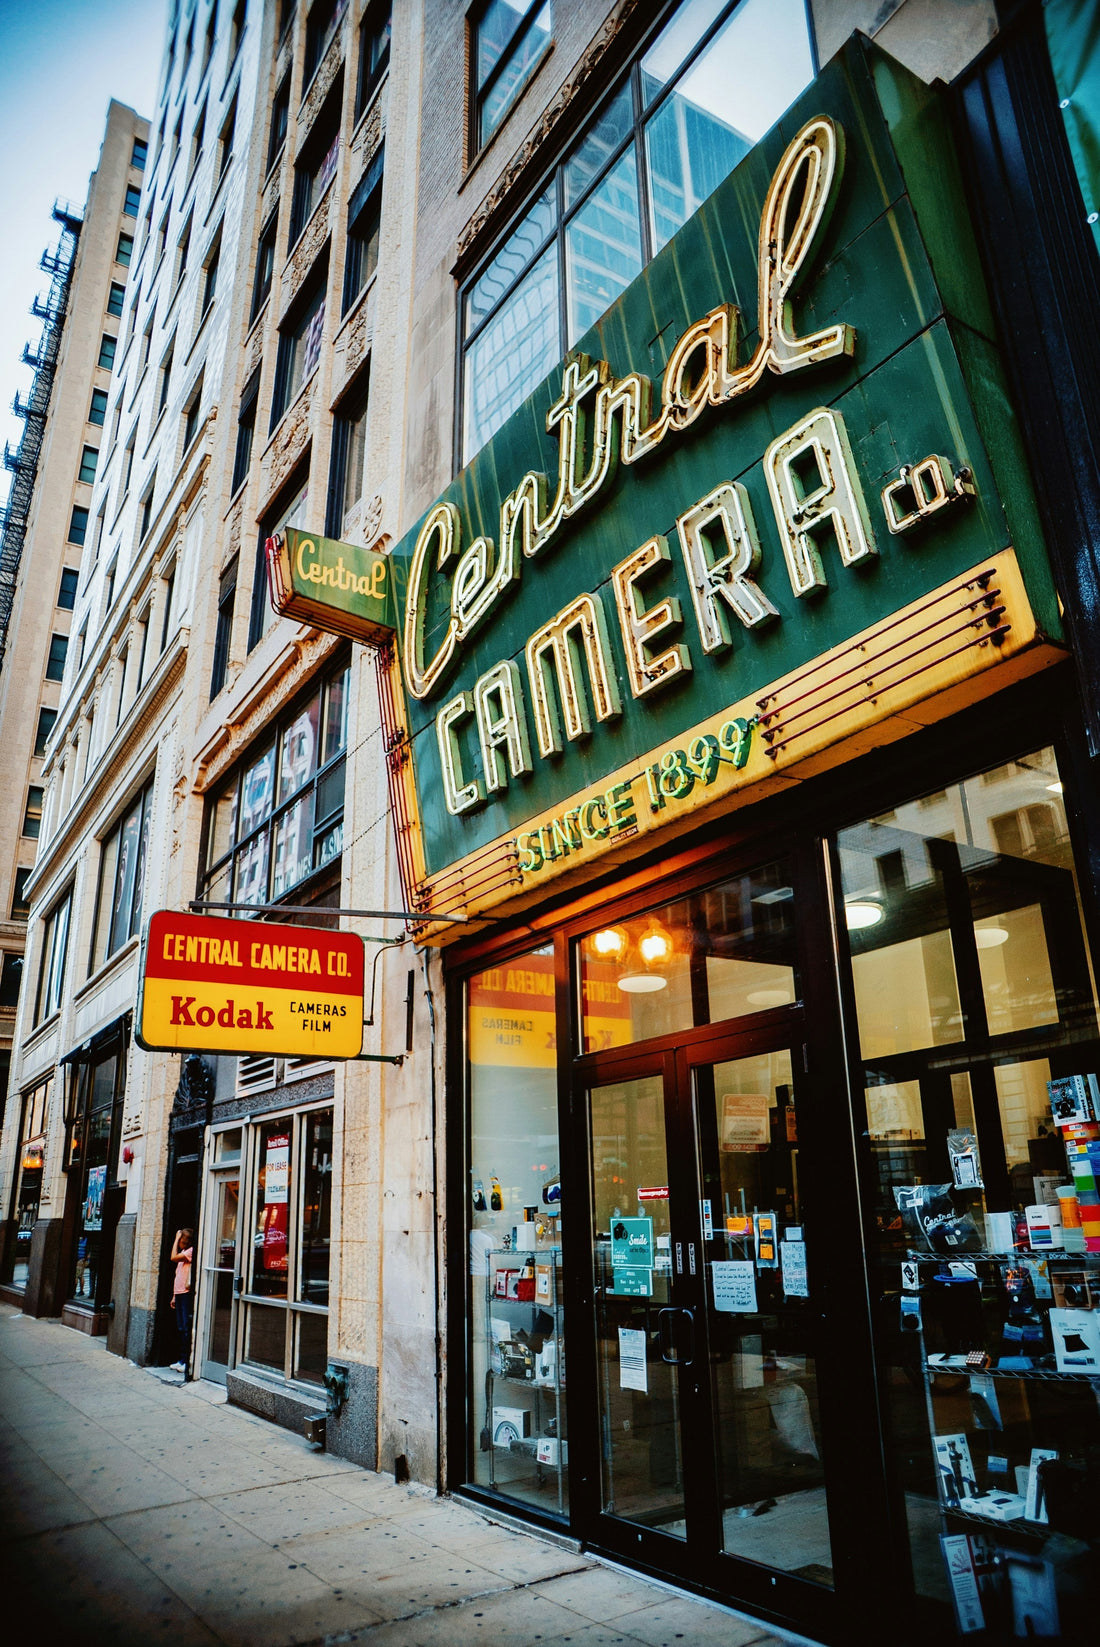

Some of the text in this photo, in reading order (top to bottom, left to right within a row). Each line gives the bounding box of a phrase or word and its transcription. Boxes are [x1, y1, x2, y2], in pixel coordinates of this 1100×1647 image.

[403, 113, 856, 700] Central
[296, 538, 387, 600] Central
[435, 406, 878, 816] CAMERA
[516, 717, 752, 872] SINCE 1899
[162, 933, 352, 978] CENTRAL CAMERA CO.
[170, 996, 274, 1031] Kodak
[289, 1001, 347, 1018] CAMERAS
[302, 1019, 332, 1033] FILM
